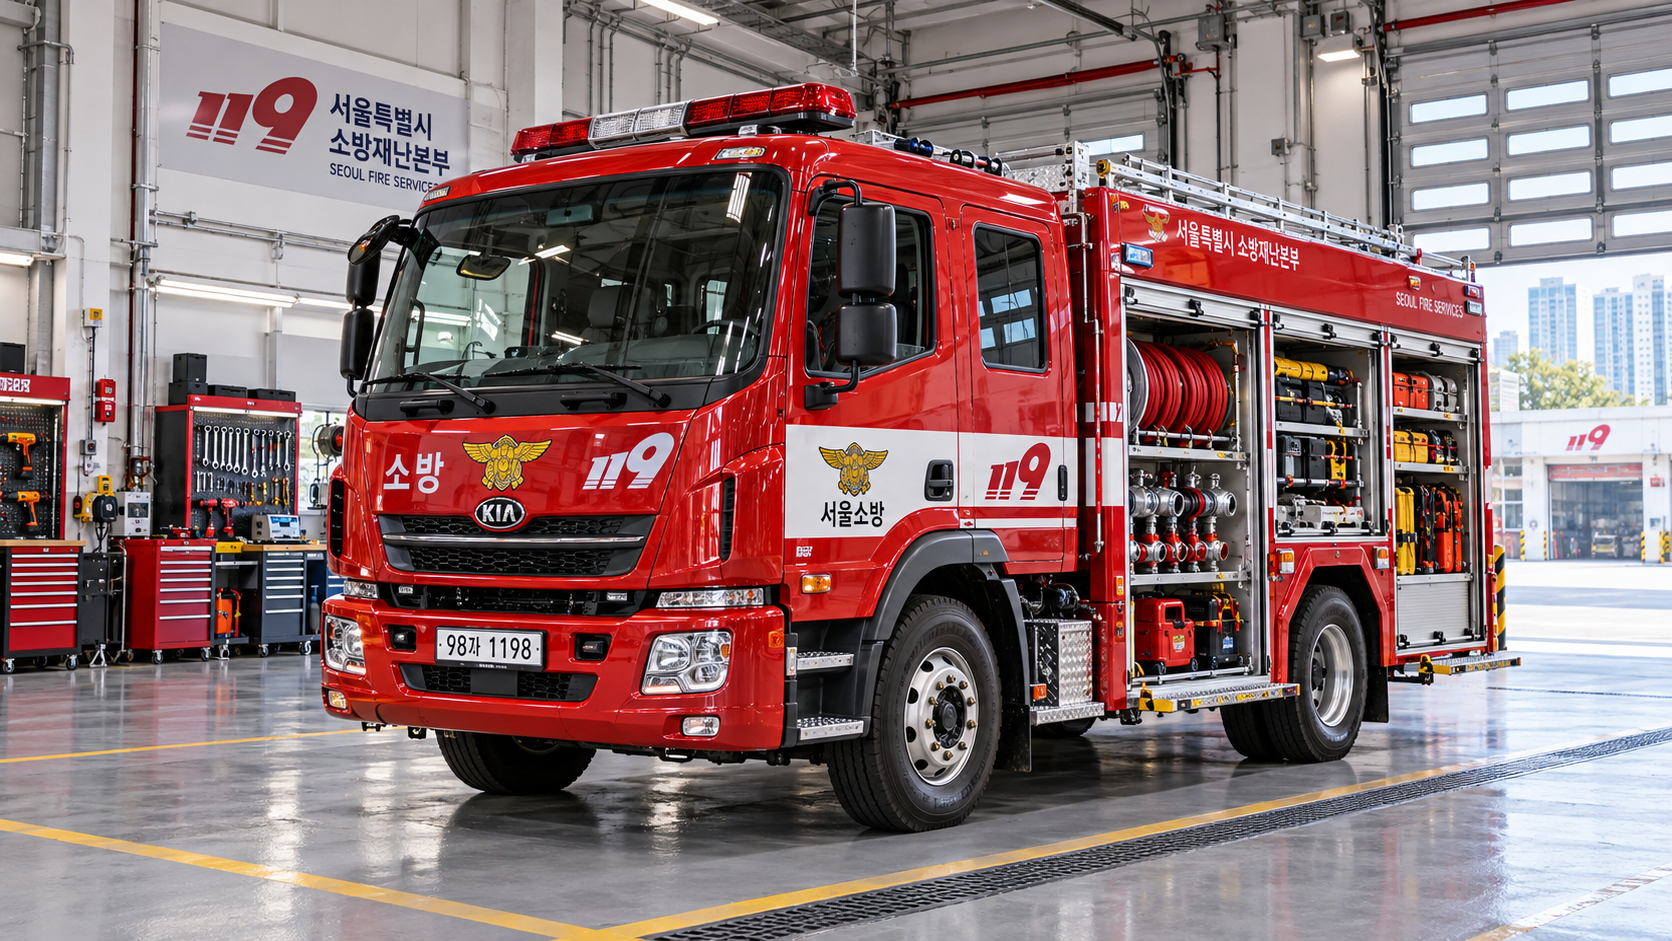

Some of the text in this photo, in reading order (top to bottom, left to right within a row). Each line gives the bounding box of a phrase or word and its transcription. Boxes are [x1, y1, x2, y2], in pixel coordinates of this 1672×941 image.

[186, 76, 318, 155] 119
[329, 93, 432, 141] 서울특별시
[329, 129, 450, 176] 소방재난본부
[329, 162, 365, 181] SEOUL
[368, 170, 391, 186] FIRE
[1176, 219, 1300, 271] 서울특별시 소방재난본부
[1395, 291, 1464, 318] SEOUL FIRE SERVICES
[1565, 424, 1611, 451] 119
[383, 451, 444, 494] 소방
[582, 432, 675, 490] 119
[984, 442, 1051, 500] 119
[482, 503, 516, 523] KIA
[820, 500, 885, 528] 서울소방
[489, 636, 531, 660] 1198
